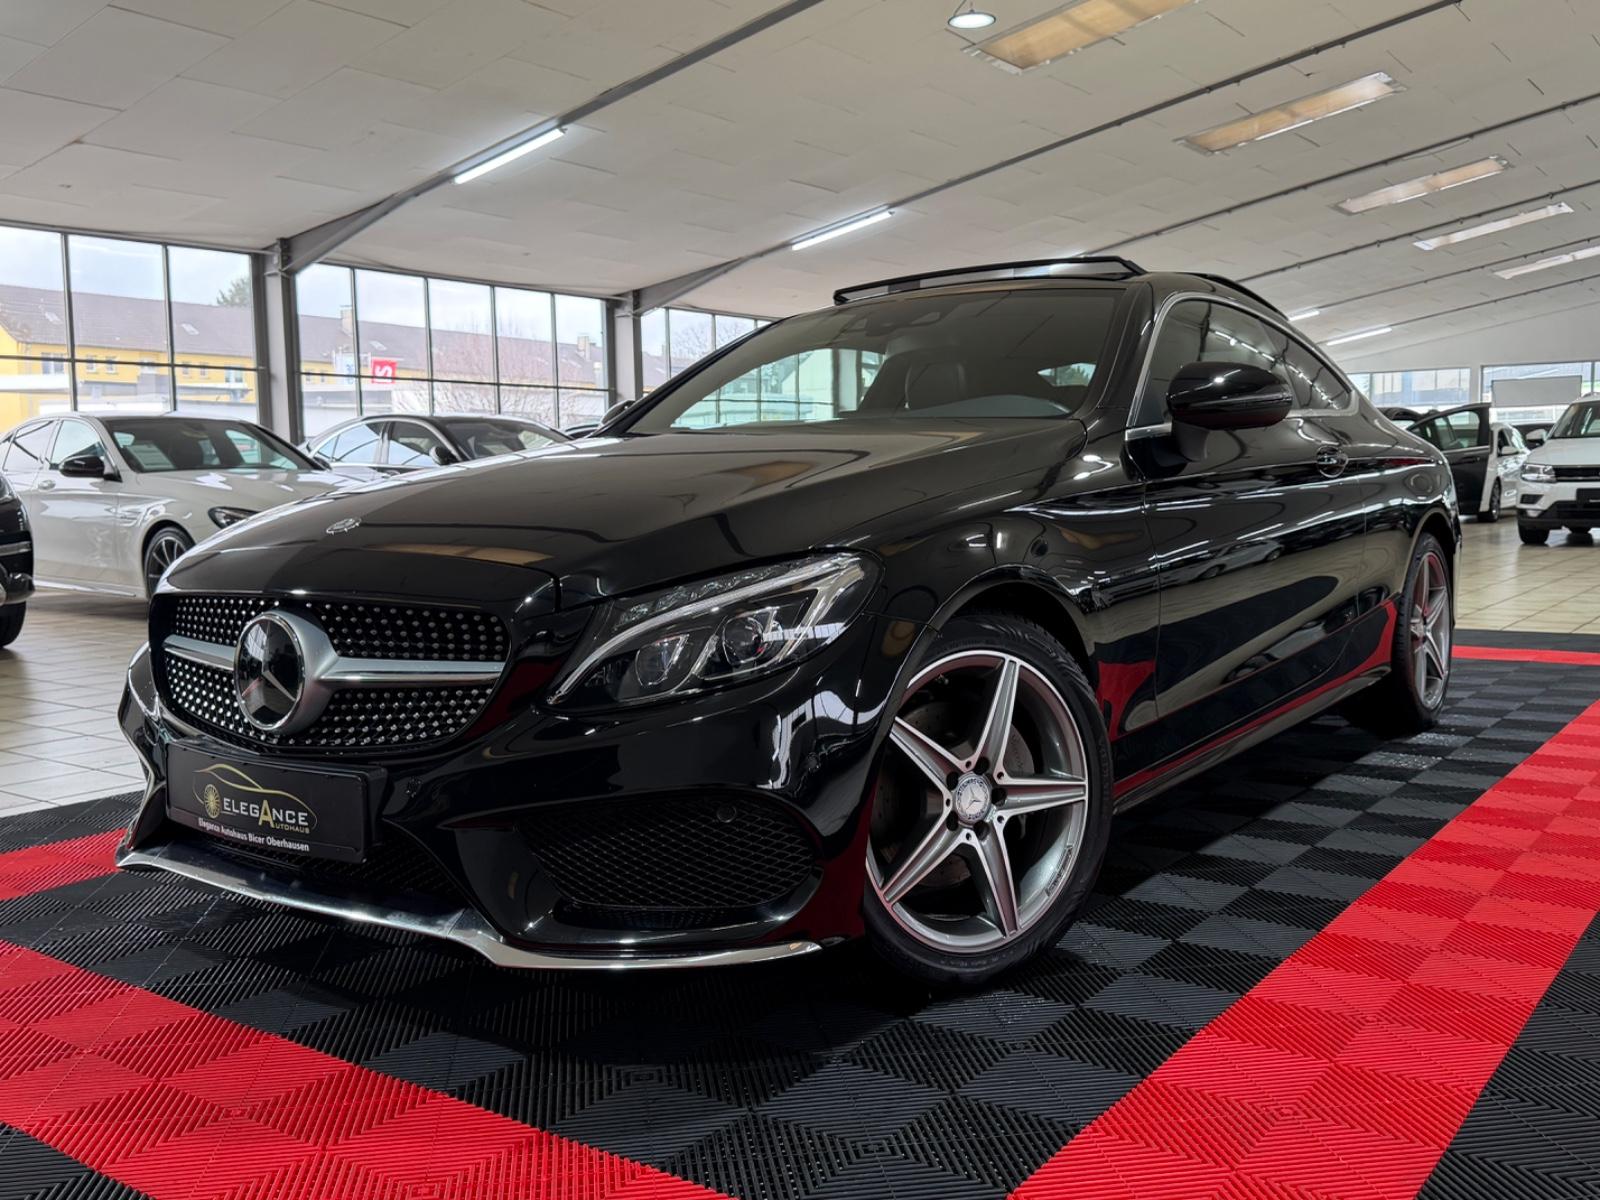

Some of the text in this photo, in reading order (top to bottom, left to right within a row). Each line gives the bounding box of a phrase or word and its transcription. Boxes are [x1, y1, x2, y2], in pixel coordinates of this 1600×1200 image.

[223, 797, 309, 828] ELEGANCE
[198, 817, 310, 852] Elegance Autohaus Bicer Oberhausen
